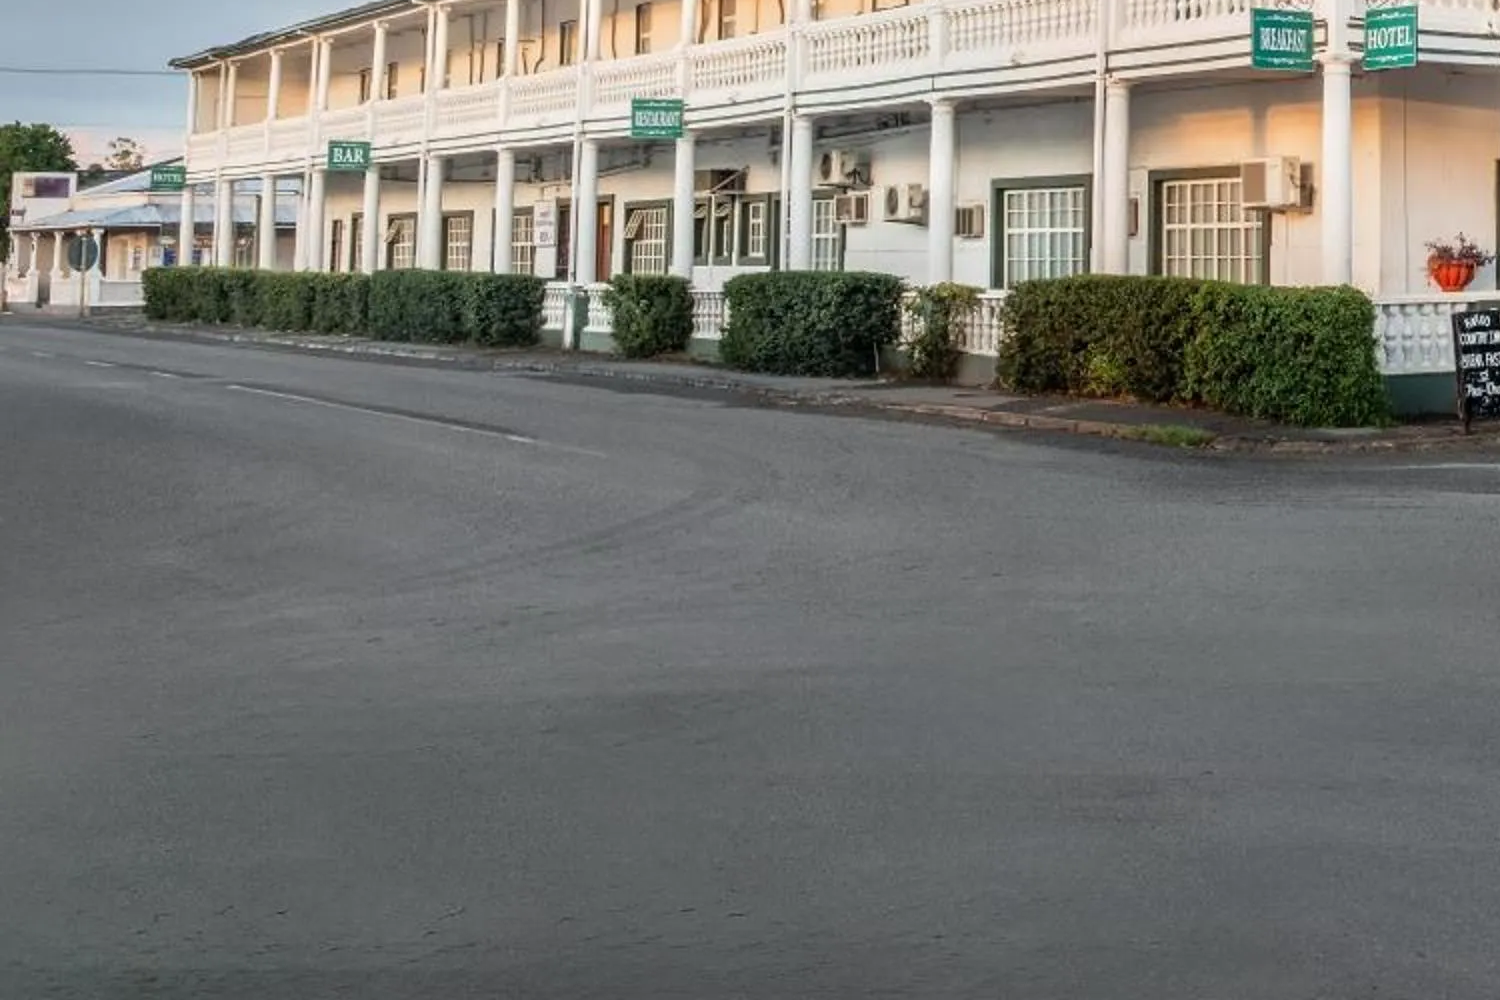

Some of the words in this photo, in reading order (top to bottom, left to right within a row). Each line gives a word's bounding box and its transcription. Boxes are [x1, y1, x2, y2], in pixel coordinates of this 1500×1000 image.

[1259, 26, 1308, 52] BREAKFAST
[1367, 26, 1412, 49] HOTEL
[332, 147, 364, 162] BAR
